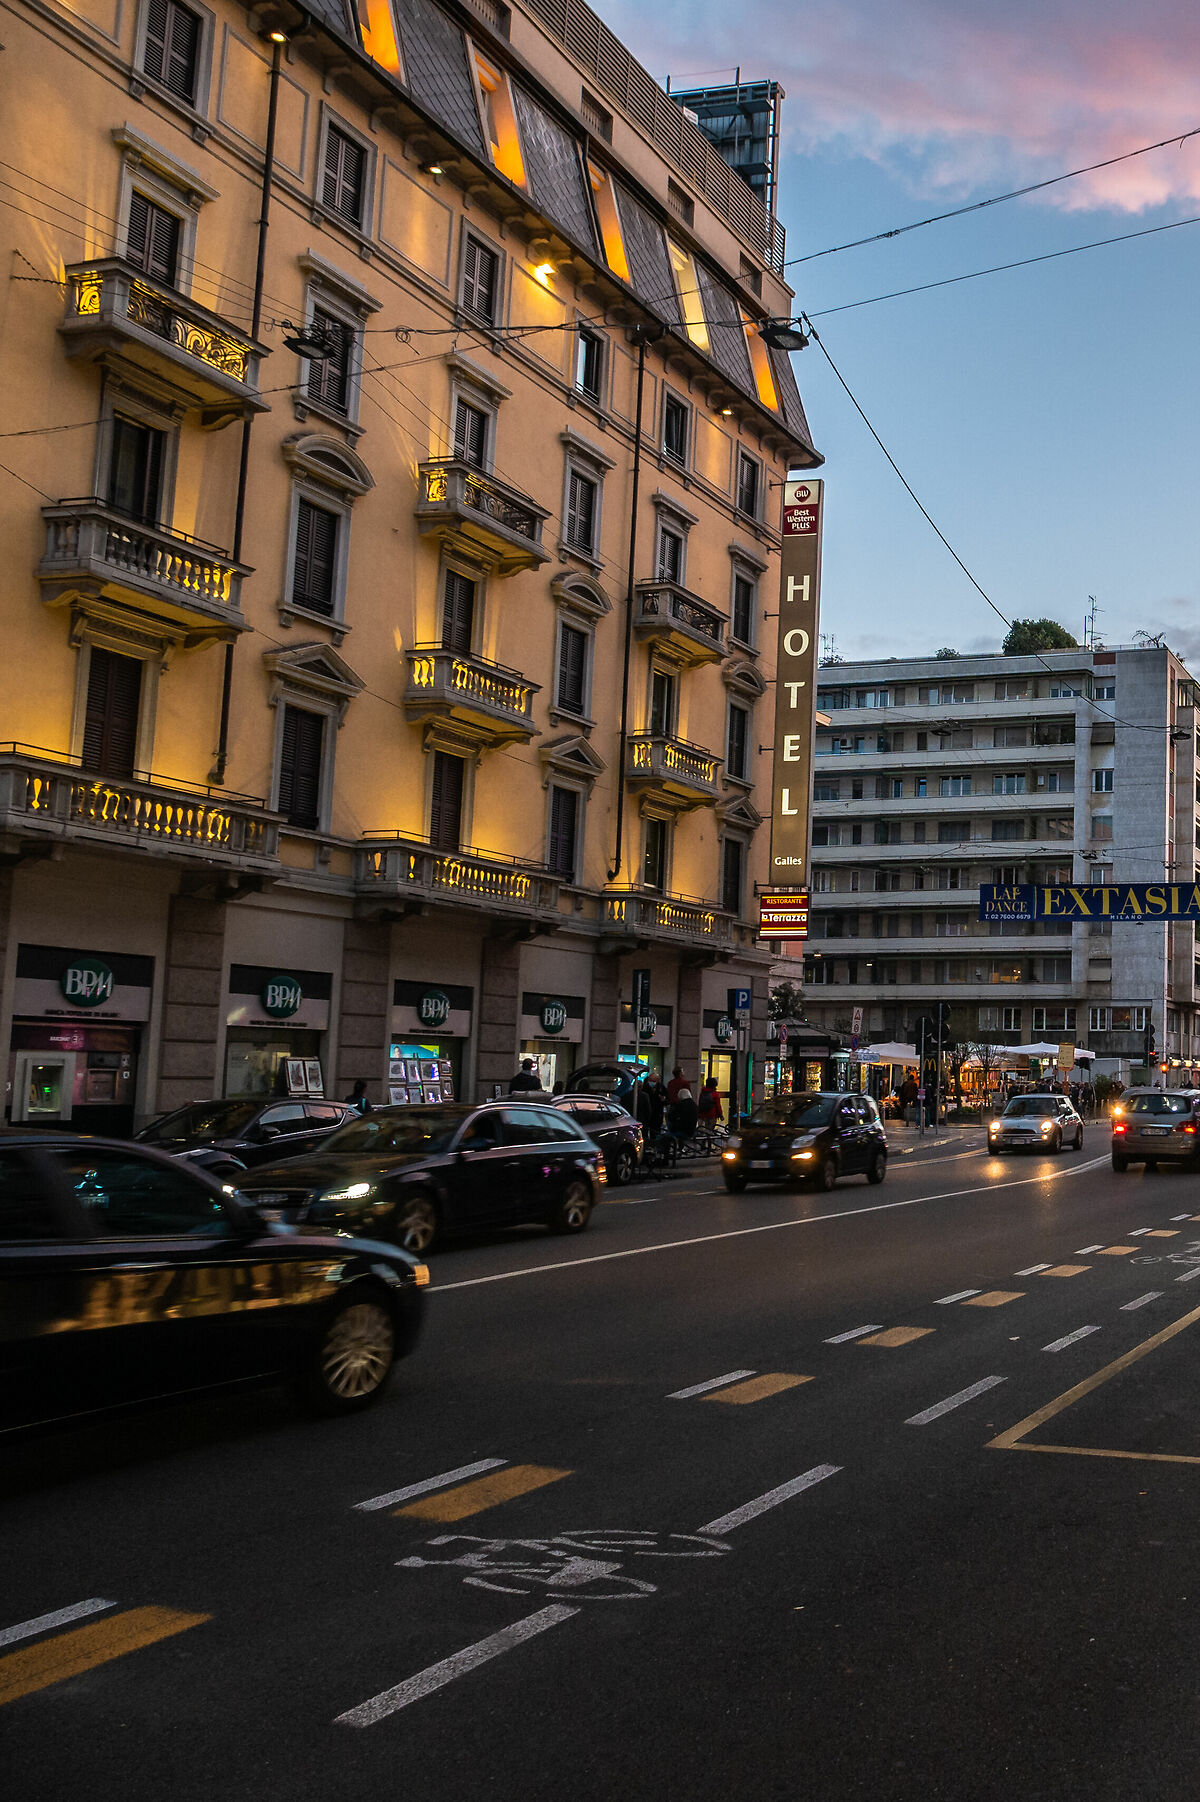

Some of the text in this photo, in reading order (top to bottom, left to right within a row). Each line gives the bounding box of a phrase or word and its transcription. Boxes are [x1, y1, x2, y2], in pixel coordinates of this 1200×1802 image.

[796, 490, 809, 498] BW
[787, 515, 816, 523] Western
[781, 574, 811, 816] HOTEL
[775, 857, 802, 866] Galles
[993, 886, 1021, 900] LAP
[986, 901, 1027, 912] DANCE
[769, 913, 807, 922] Terrazza
[66, 969, 113, 998] BPM
[266, 984, 302, 1009] BPM
[738, 991, 748, 1007] P
[422, 998, 450, 1019] BPM
[544, 1007, 566, 1027] BPM
